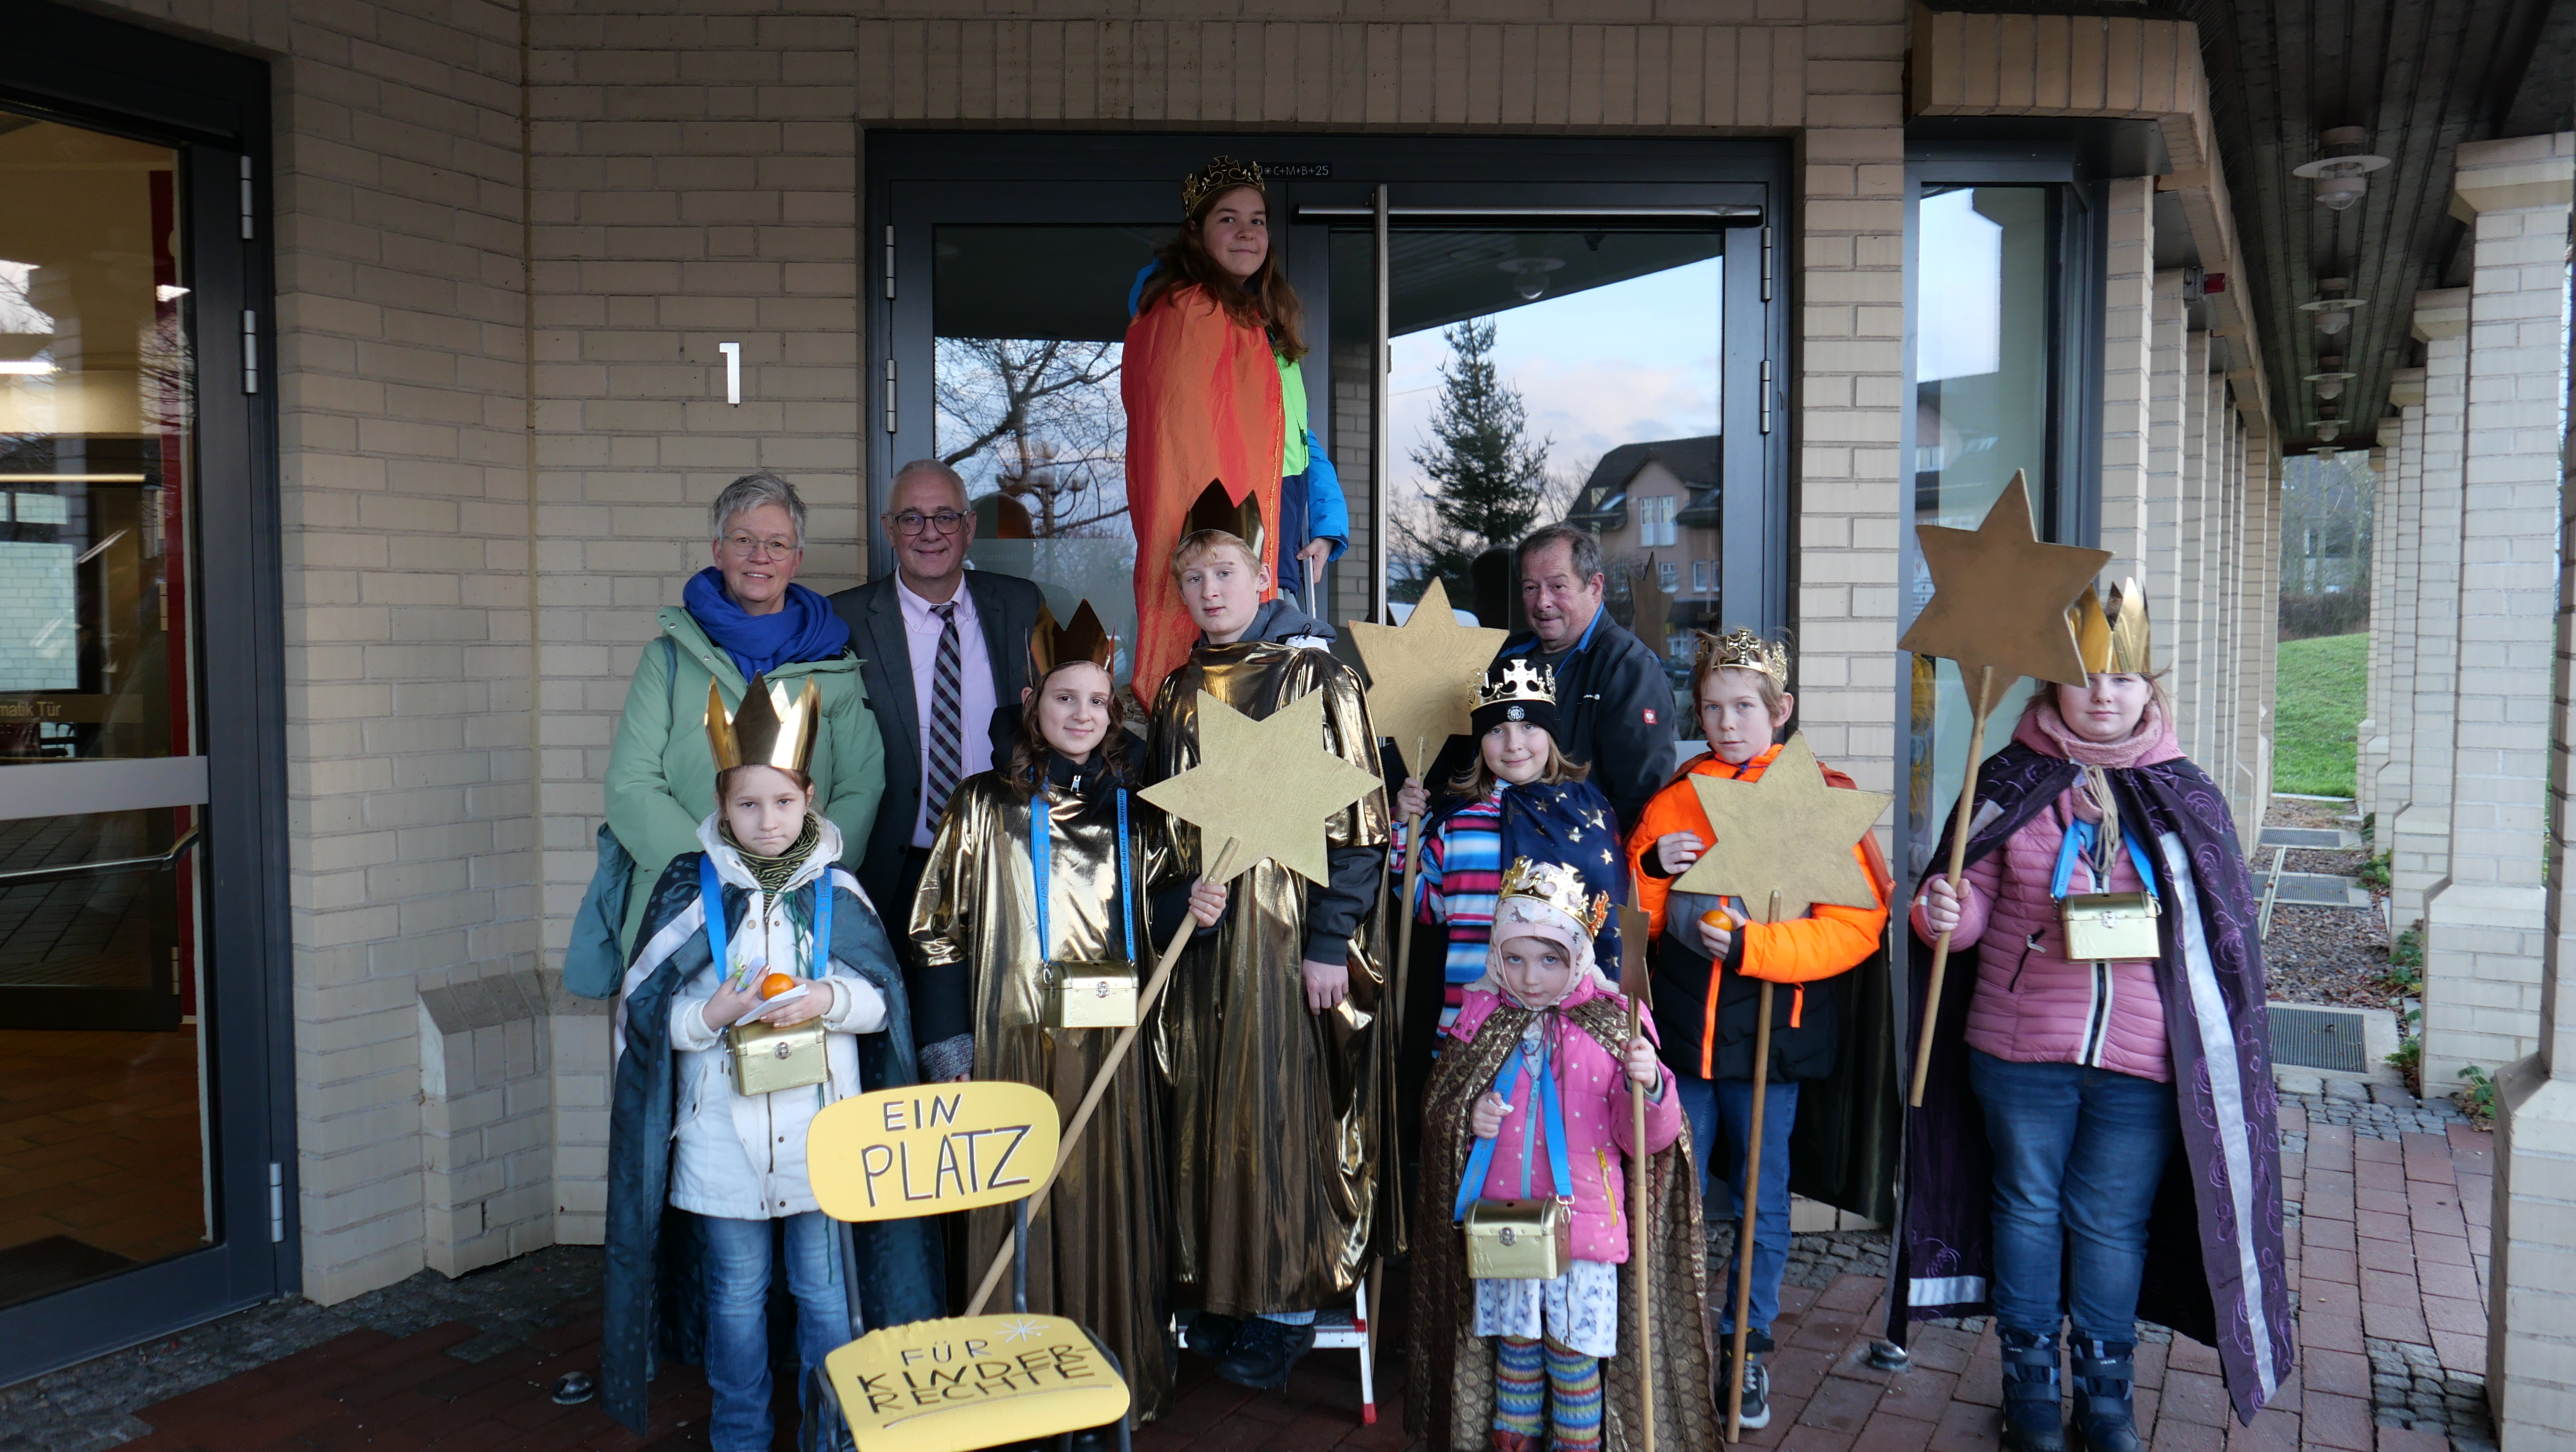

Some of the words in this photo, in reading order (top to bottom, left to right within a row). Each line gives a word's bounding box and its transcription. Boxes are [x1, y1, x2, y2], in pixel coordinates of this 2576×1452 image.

[720, 342, 740, 404] 1
[36, 701, 62, 716] Tür
[883, 1093, 962, 1132] EIN
[860, 1124, 1034, 1208] PLATZ
[900, 1338, 993, 1367] FÜR
[868, 1358, 1095, 1414] RECHTE
